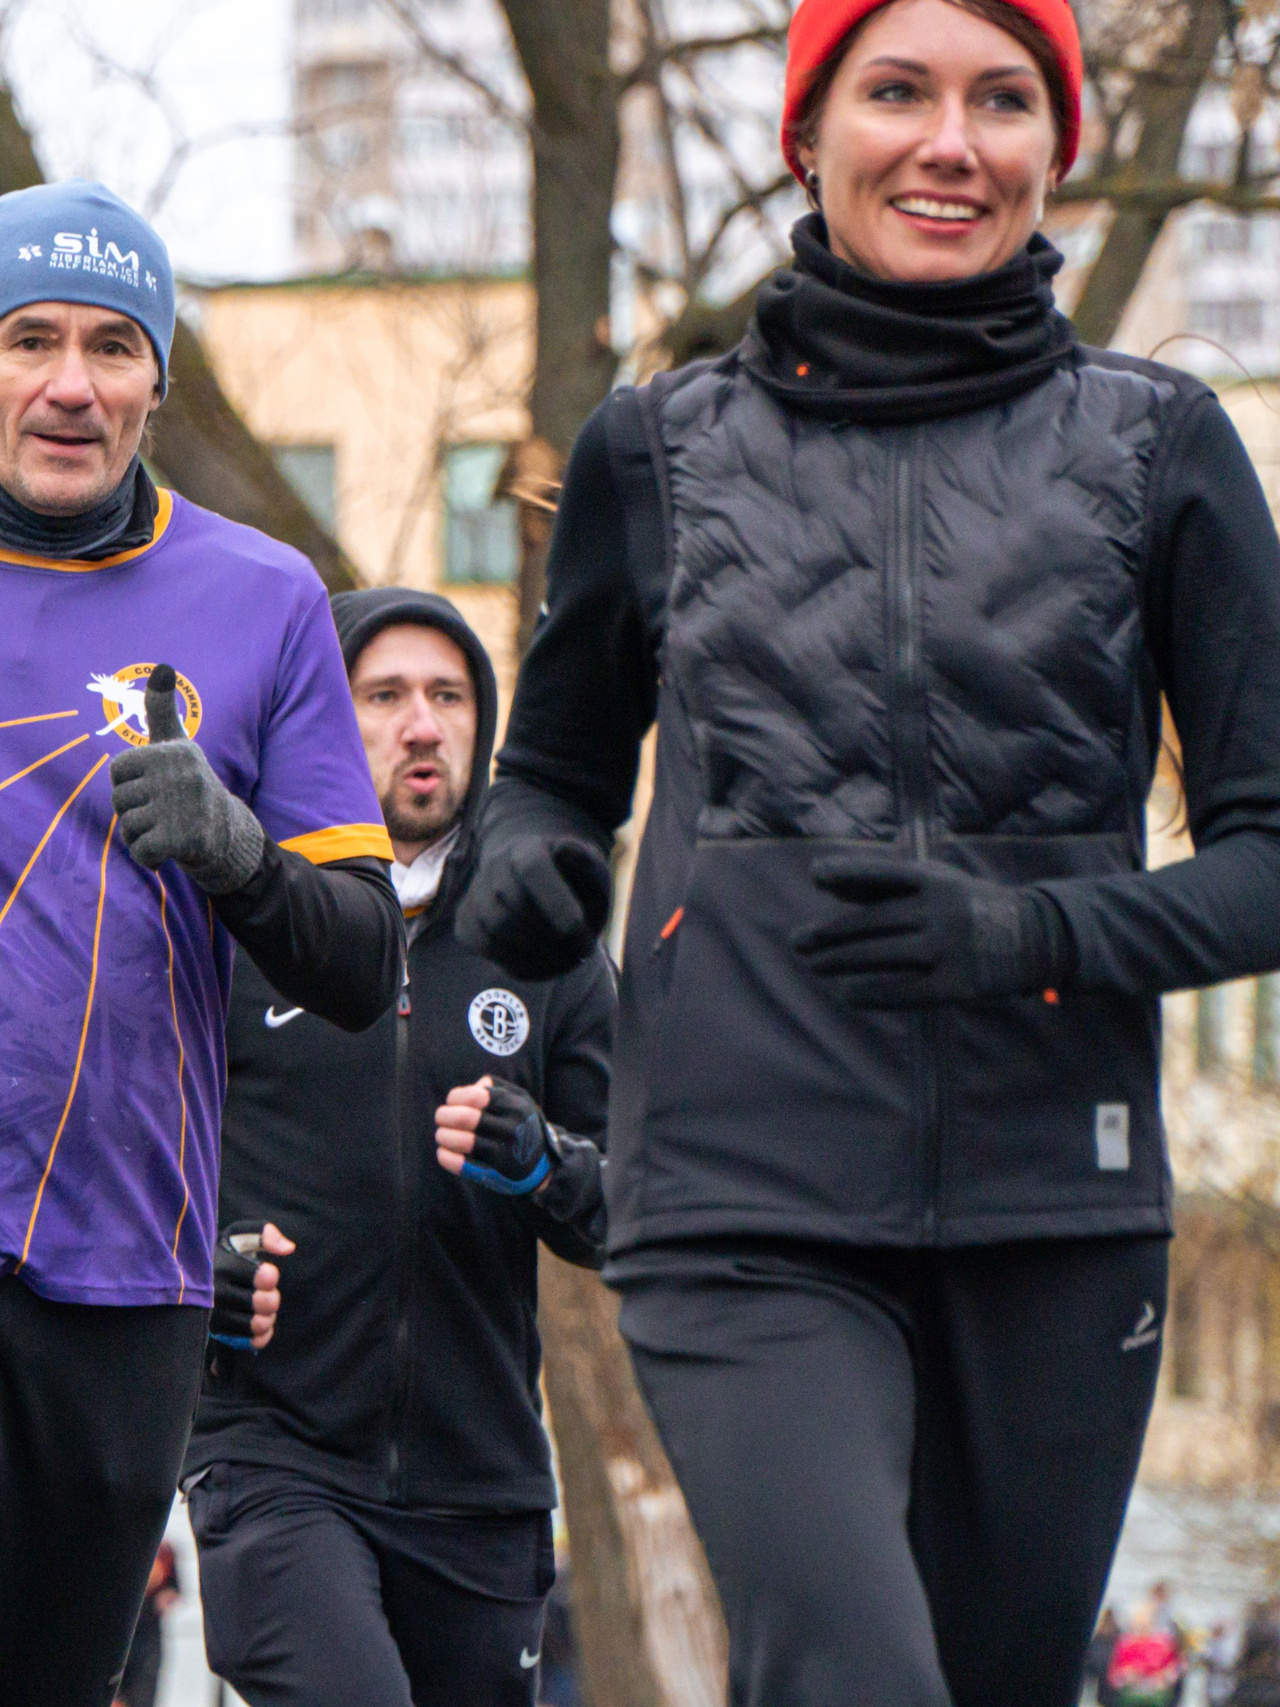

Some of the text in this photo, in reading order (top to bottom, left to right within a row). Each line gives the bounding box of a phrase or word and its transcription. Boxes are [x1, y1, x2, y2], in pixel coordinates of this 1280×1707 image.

[49, 260, 139, 288] HALF MARATHON
[51, 252, 139, 281] SIBERIAN ICE
